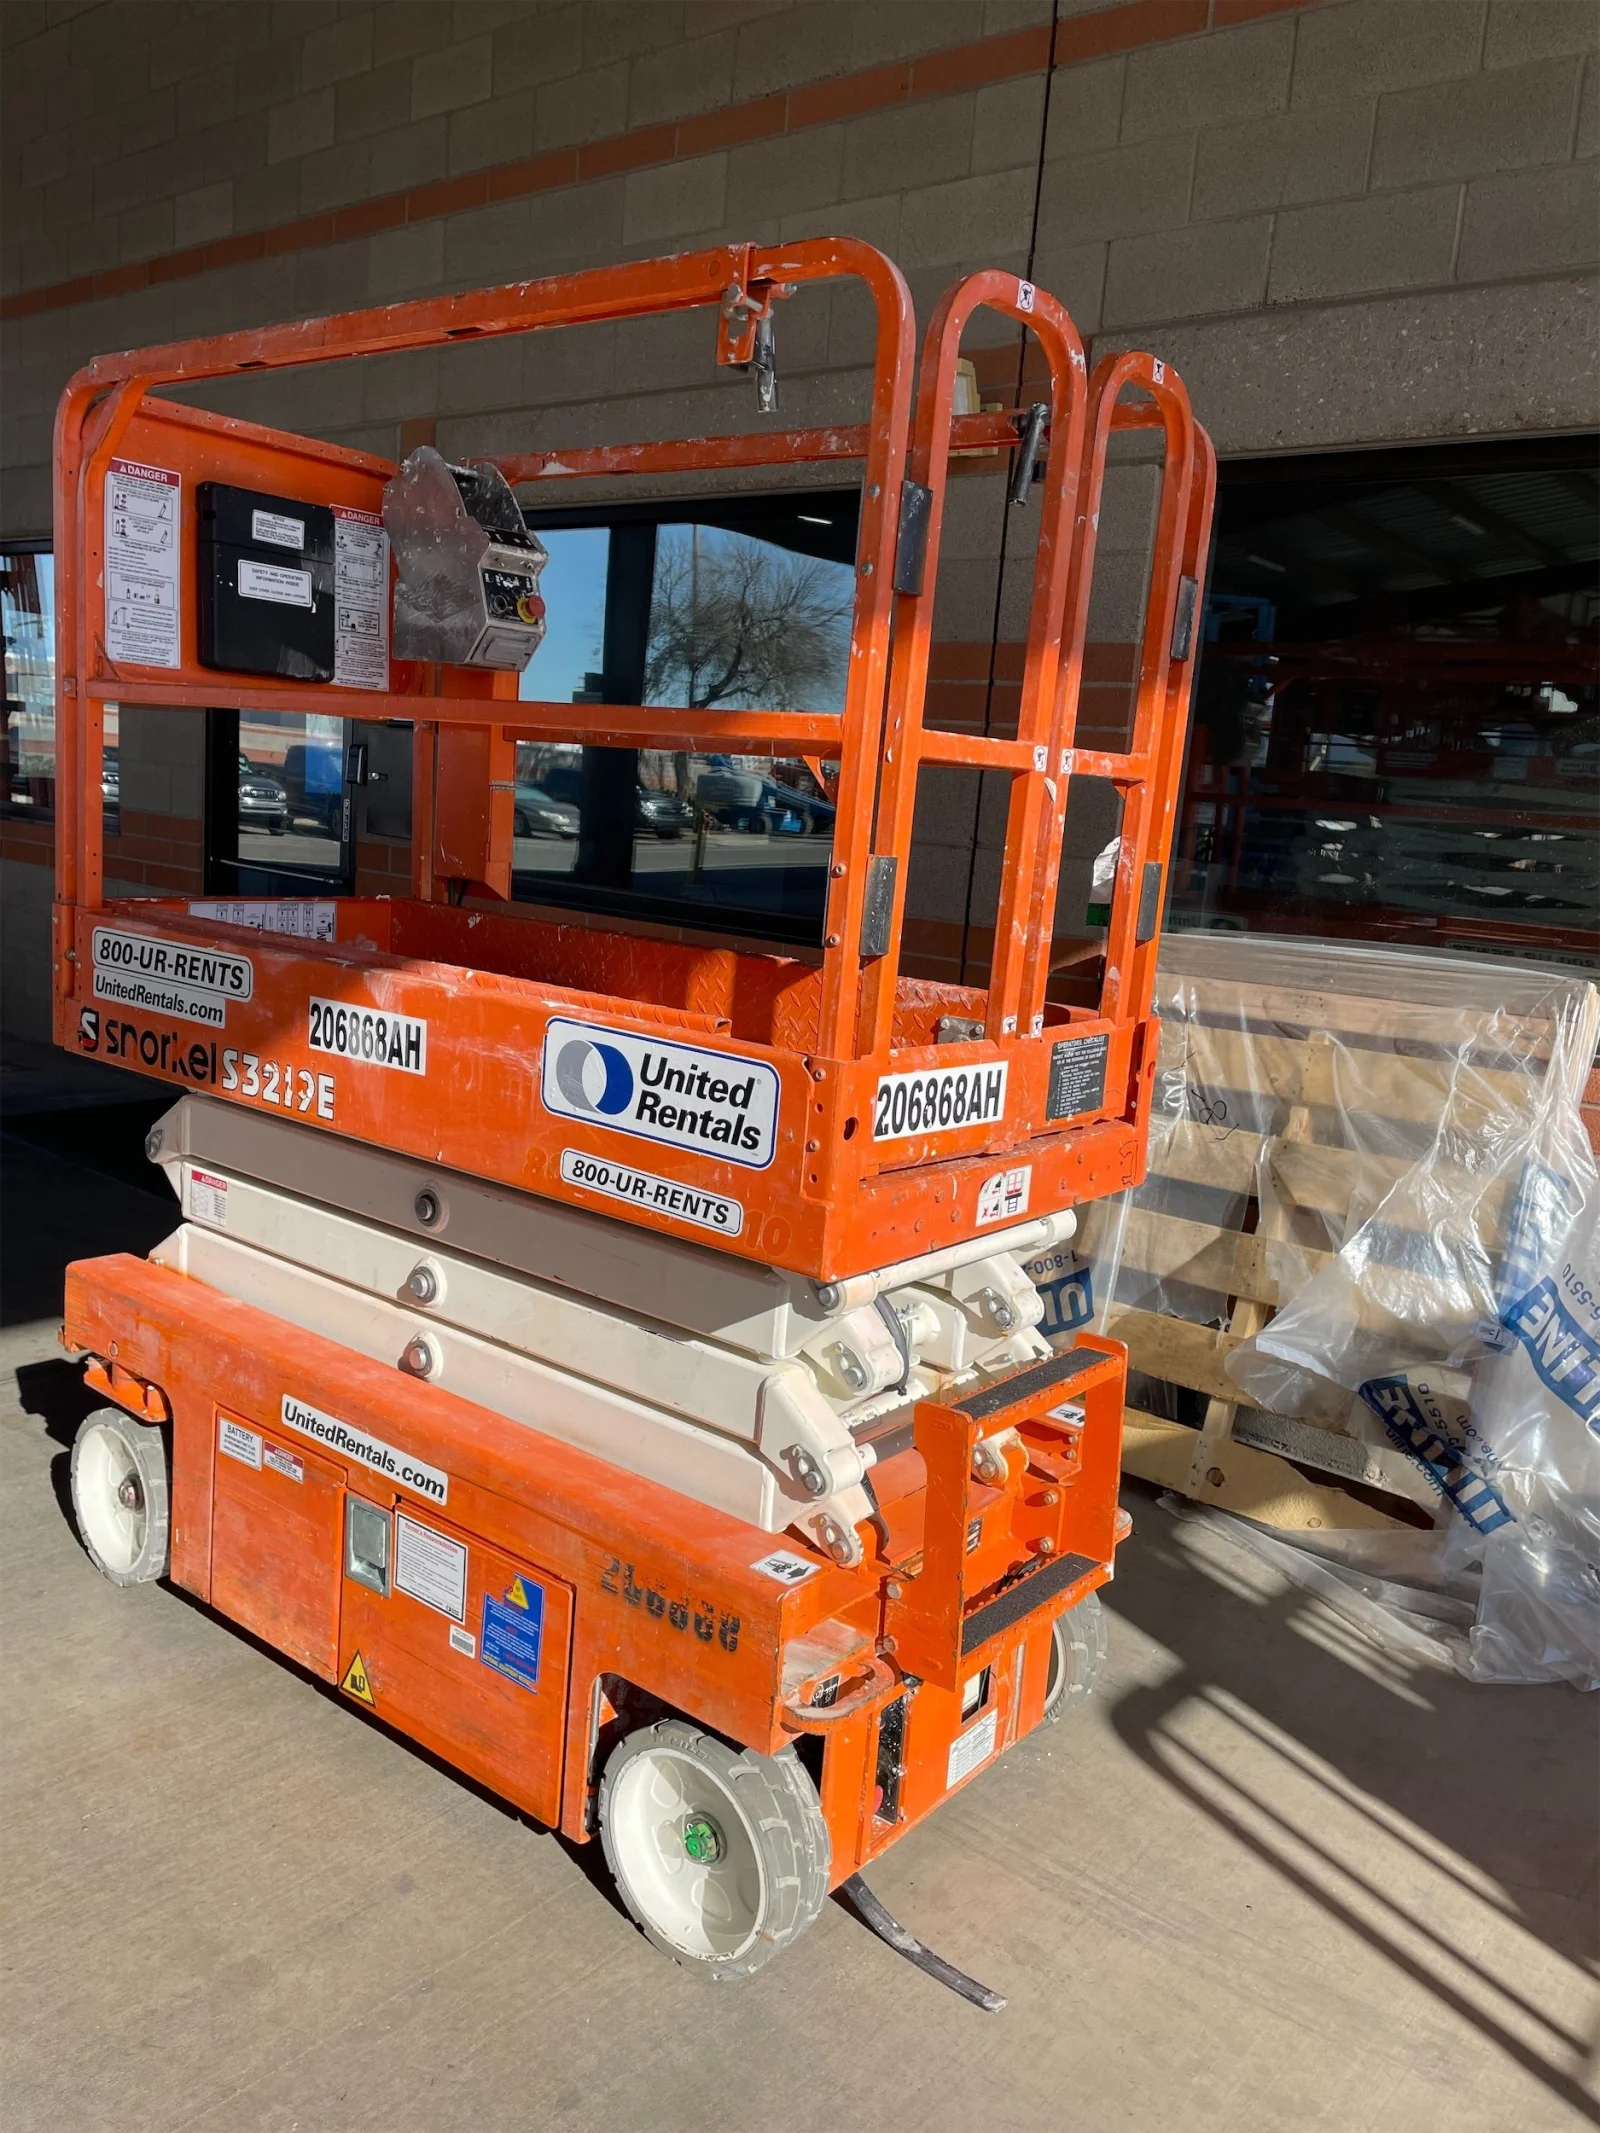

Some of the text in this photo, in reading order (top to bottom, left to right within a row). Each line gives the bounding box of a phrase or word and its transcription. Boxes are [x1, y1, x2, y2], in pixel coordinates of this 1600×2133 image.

[128, 465, 168, 482] DANGER
[347, 511, 380, 525] DANGER
[252, 568, 269, 576] SAFETY
[99, 938, 244, 991] 800-UR-RENTS
[95, 975, 224, 1023] UnitedRentals.com
[310, 1003, 421, 1070] 206868AH
[639, 1053, 756, 1110] United
[874, 1069, 1002, 1137] 206868AH
[635, 1090, 761, 1151] Rentals
[572, 1160, 729, 1225] 800-UR-RENTS
[227, 1424, 254, 1443] BATTERY
[284, 1402, 445, 1500] UnitedRentals.com
